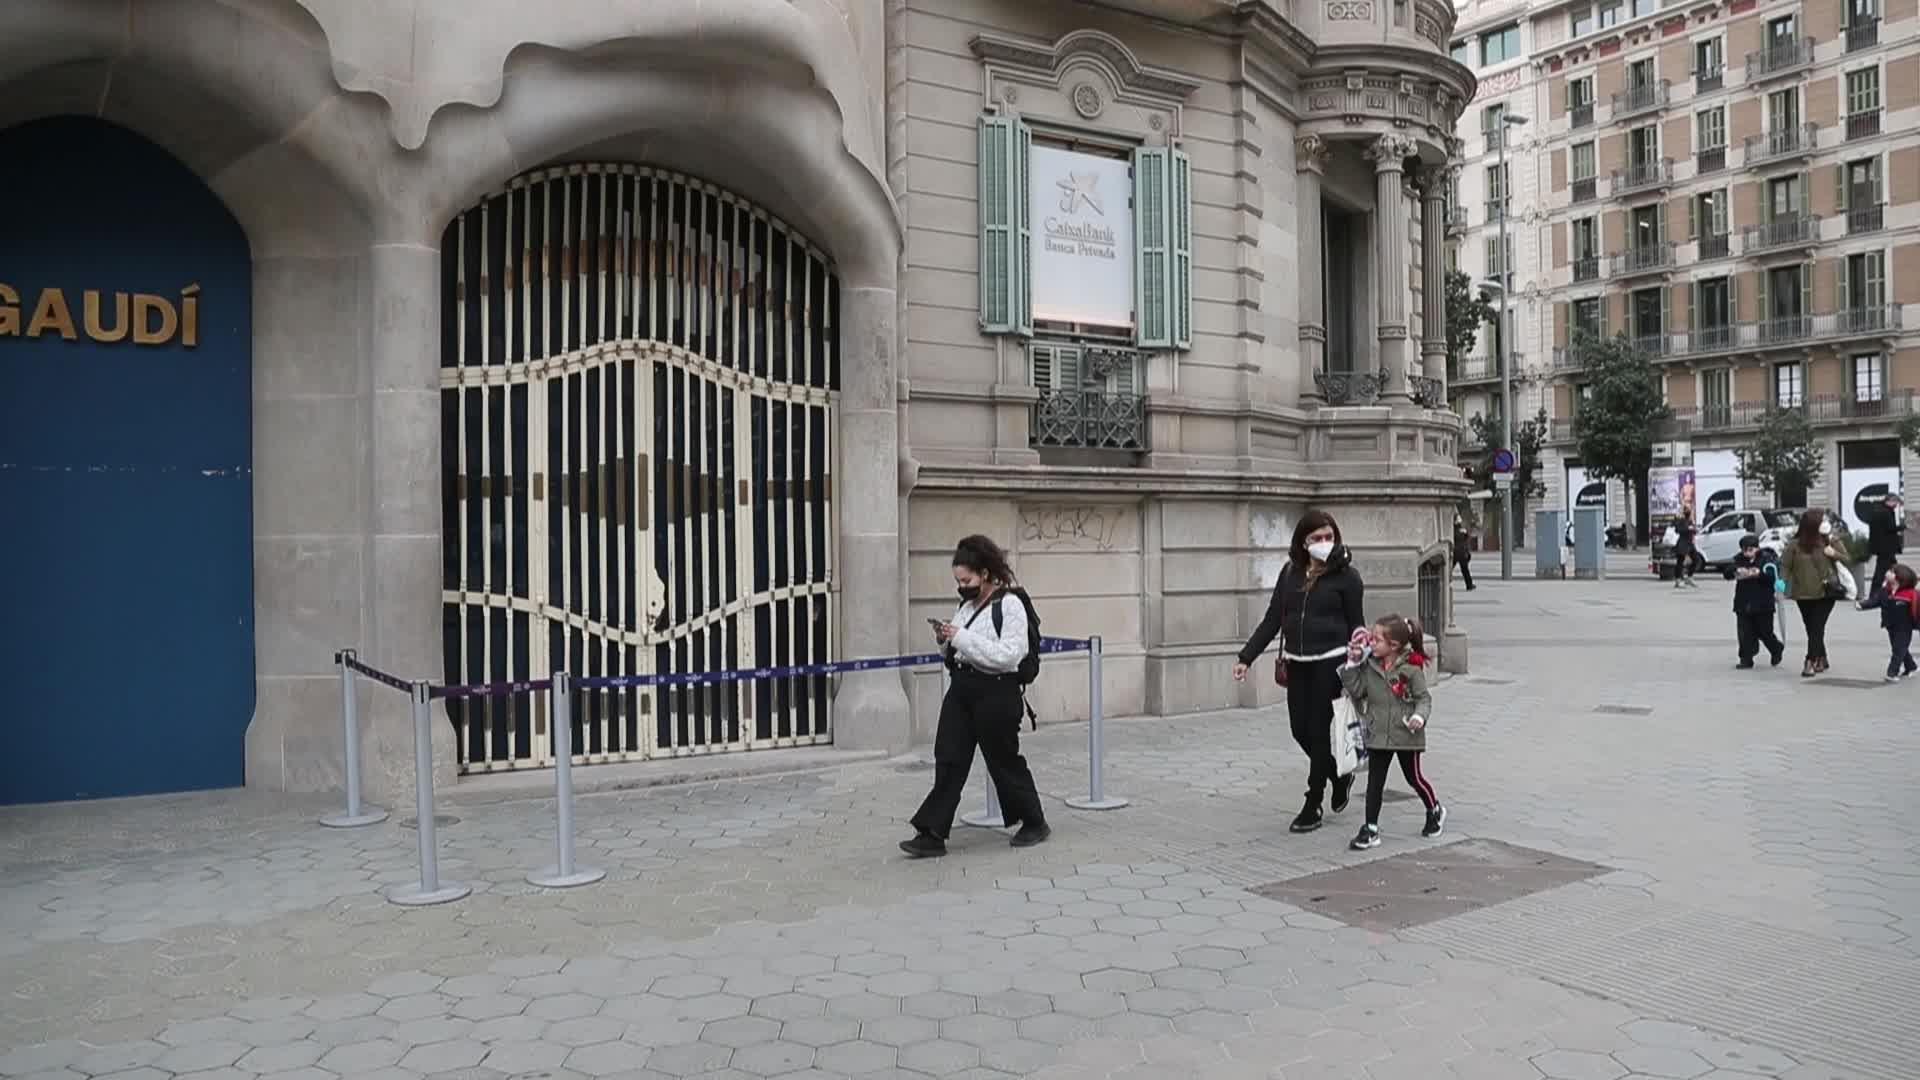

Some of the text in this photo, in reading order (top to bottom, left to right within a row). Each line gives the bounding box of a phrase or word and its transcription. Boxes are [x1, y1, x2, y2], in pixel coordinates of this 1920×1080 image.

[1044, 217, 1115, 241] CaixaBank
[1045, 239, 1115, 259] Banca Privada
